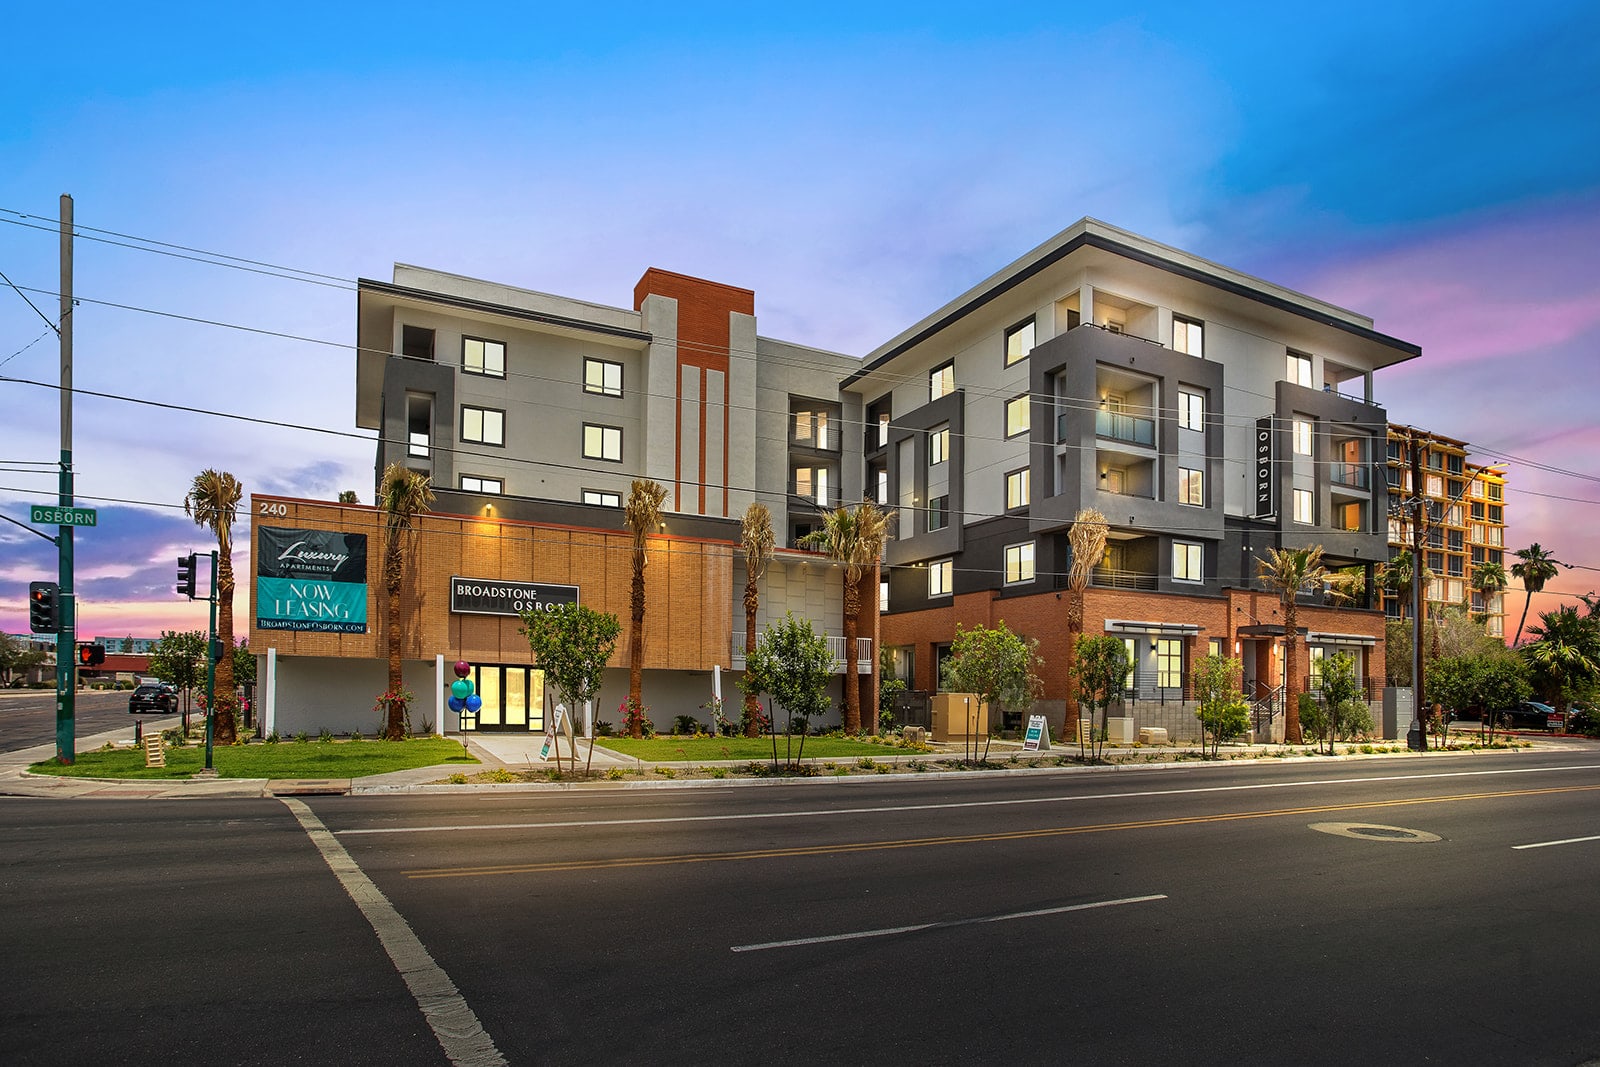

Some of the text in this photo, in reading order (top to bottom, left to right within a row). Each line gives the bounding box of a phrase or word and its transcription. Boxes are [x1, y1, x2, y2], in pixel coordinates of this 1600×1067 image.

[1259, 432, 1268, 502] OSBORN
[260, 502, 286, 516] 240
[34, 510, 94, 524] OSBORN
[278, 542, 349, 572] Luxury
[280, 563, 330, 572] APARTMENTS
[290, 584, 335, 600] NOW
[457, 585, 536, 600] BROADSTONE
[275, 600, 348, 618] LEASING
[514, 600, 564, 613] OSBOR
